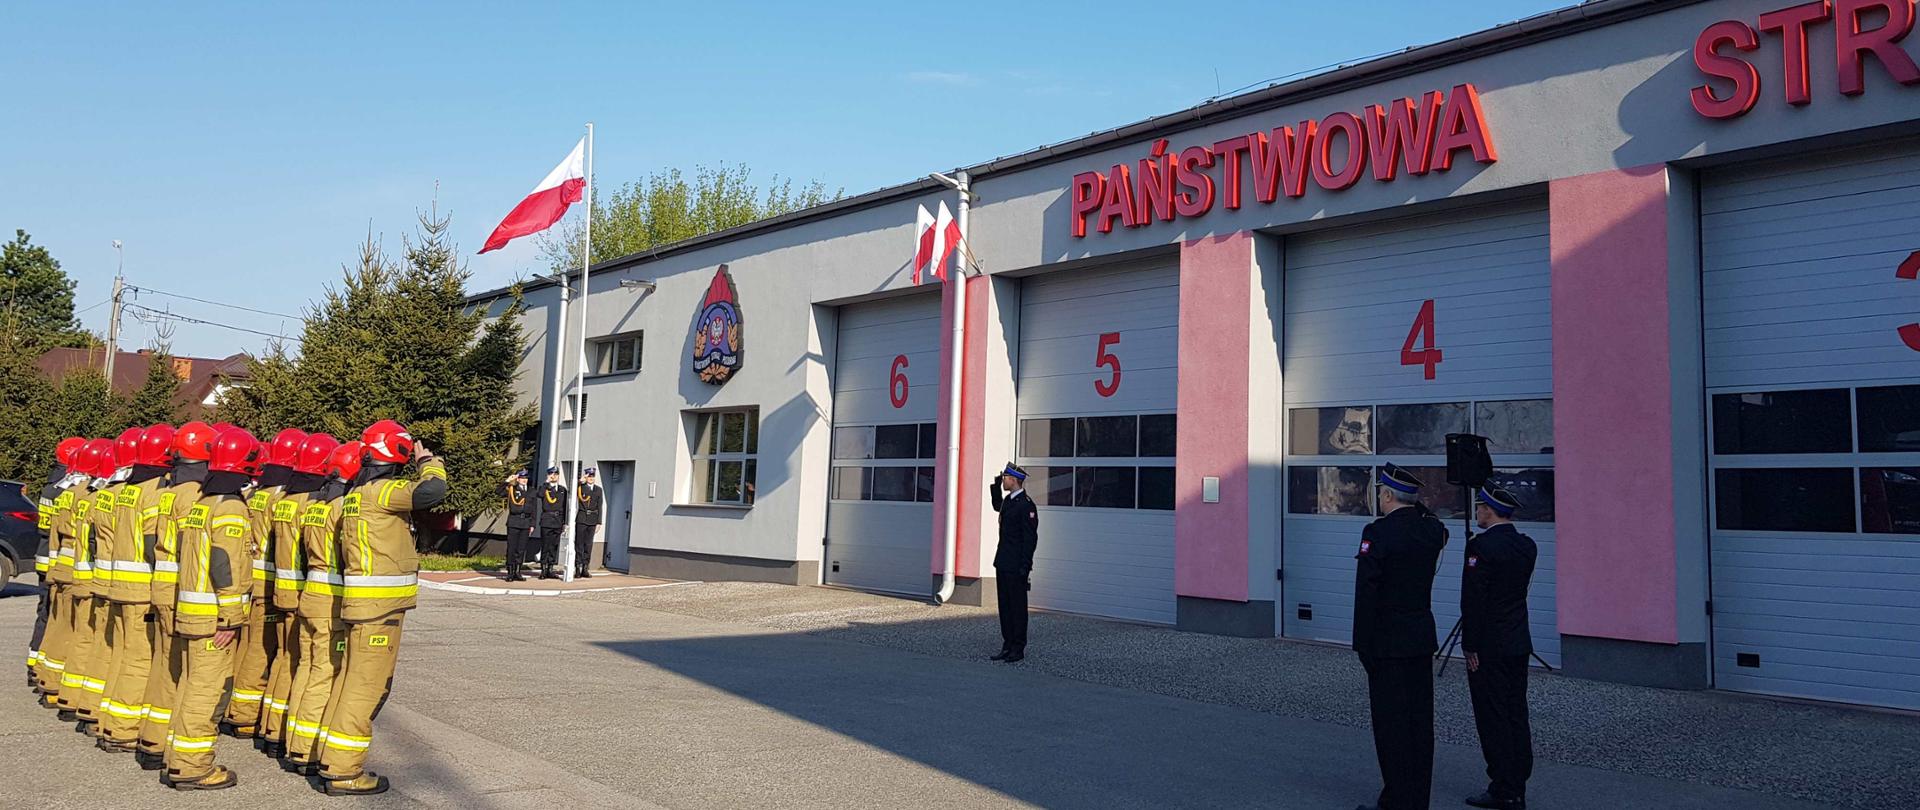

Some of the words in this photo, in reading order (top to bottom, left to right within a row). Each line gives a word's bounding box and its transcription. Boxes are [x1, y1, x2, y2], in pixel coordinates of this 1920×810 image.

[1071, 83, 1498, 238] PAŃSTWOWA
[1689, 0, 1920, 119] STR
[1095, 332, 1122, 398] 5
[1401, 299, 1443, 379] 4
[890, 355, 909, 409] 6
[228, 527, 241, 536] PSP
[371, 636, 386, 645] PSP
